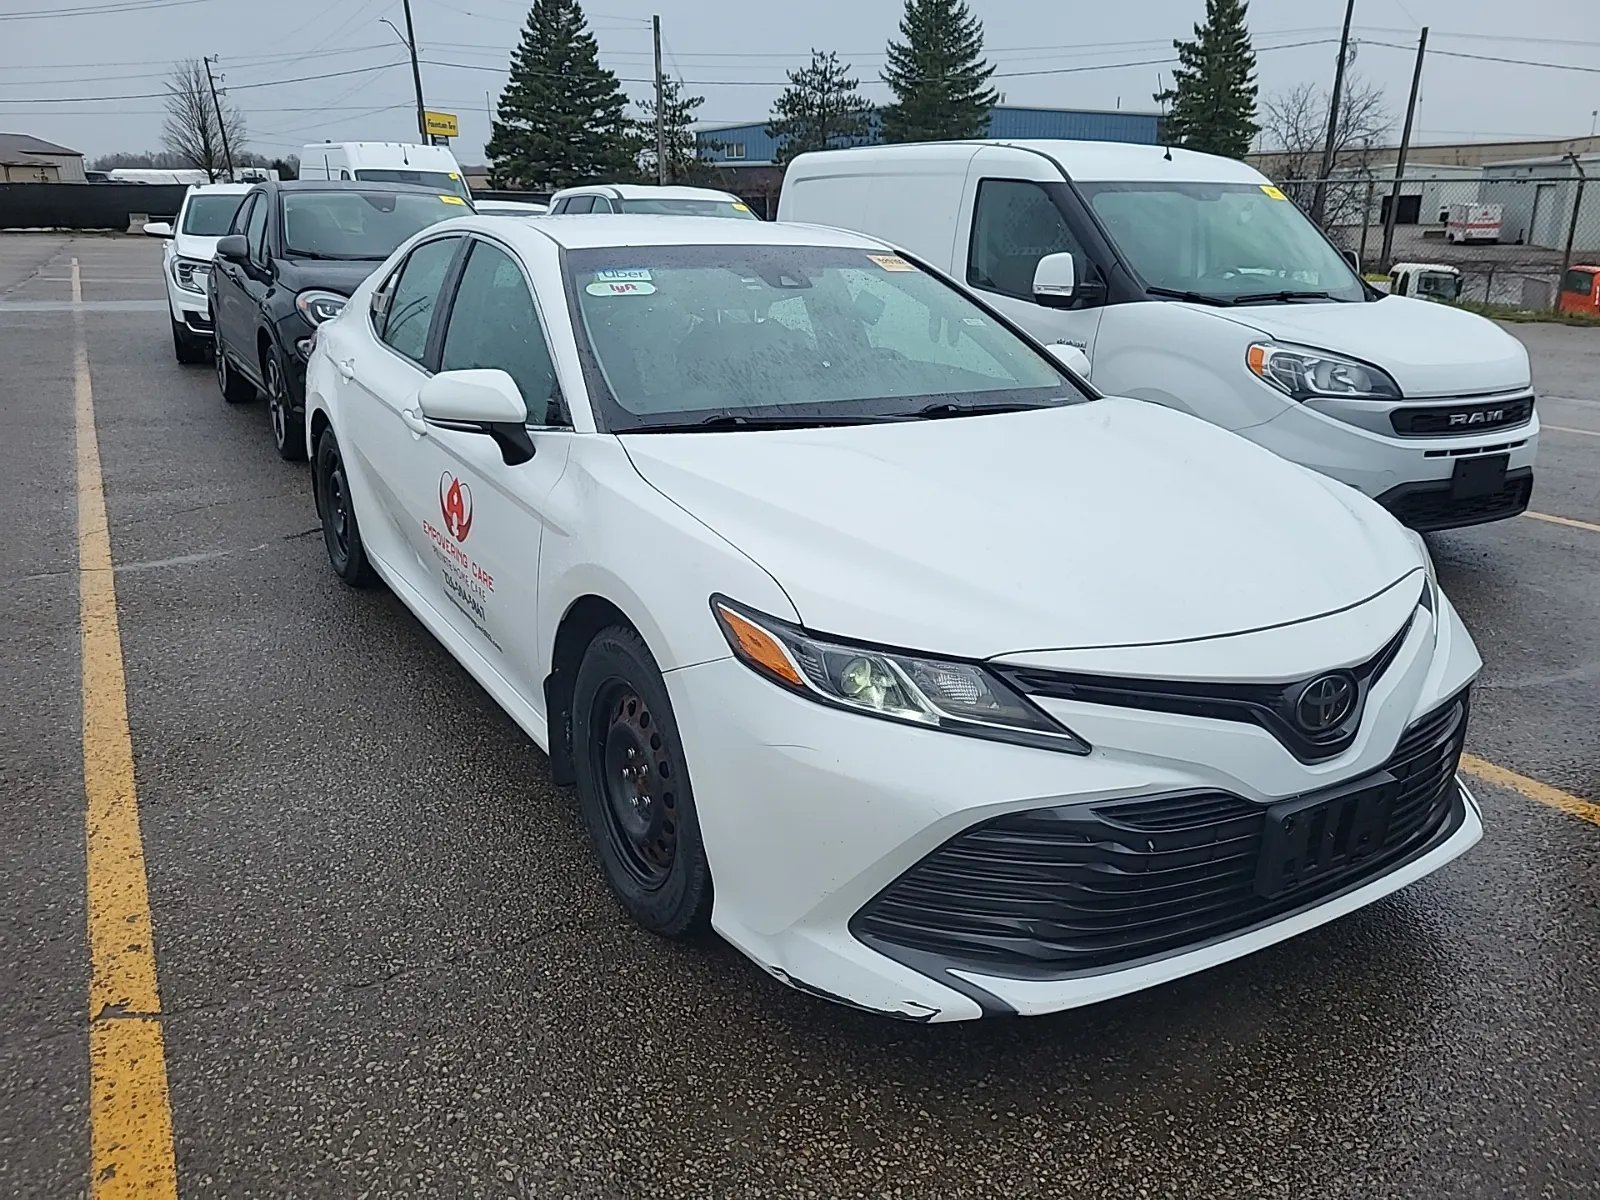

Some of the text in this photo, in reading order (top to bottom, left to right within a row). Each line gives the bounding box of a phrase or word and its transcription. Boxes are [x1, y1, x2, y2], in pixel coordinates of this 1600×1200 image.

[602, 269, 644, 279] Uber
[1448, 410, 1504, 426] RAM
[422, 519, 495, 593] EMPOWERING CARE
